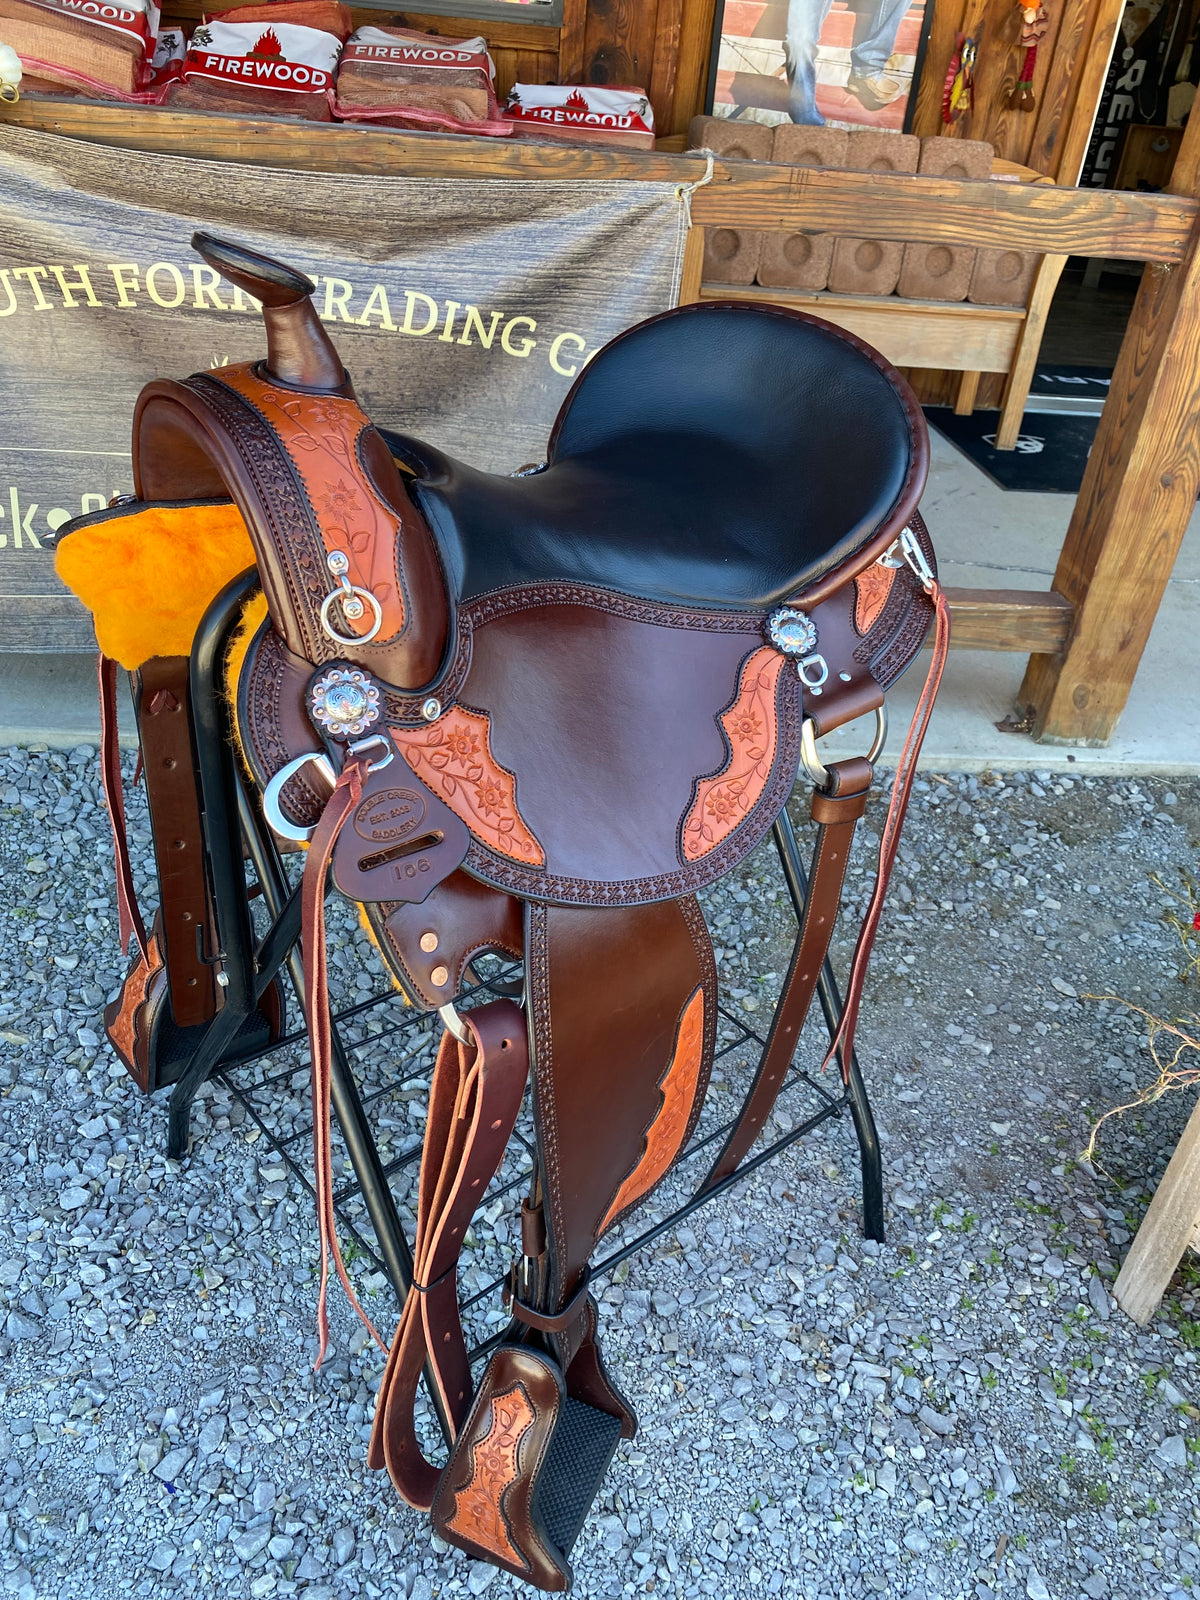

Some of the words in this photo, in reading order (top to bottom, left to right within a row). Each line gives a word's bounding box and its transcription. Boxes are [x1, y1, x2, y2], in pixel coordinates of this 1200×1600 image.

[48, 0, 136, 23] WOOD
[354, 46, 473, 62] FIREWOOD
[204, 55, 327, 87] FIREWOOD
[305, 274, 537, 357] RADING
[549, 332, 602, 377] C
[358, 792, 386, 823] DOUBLE
[387, 791, 418, 804] CREEK
[372, 815, 417, 839] SADDLERY
[394, 858, 431, 880] 106
